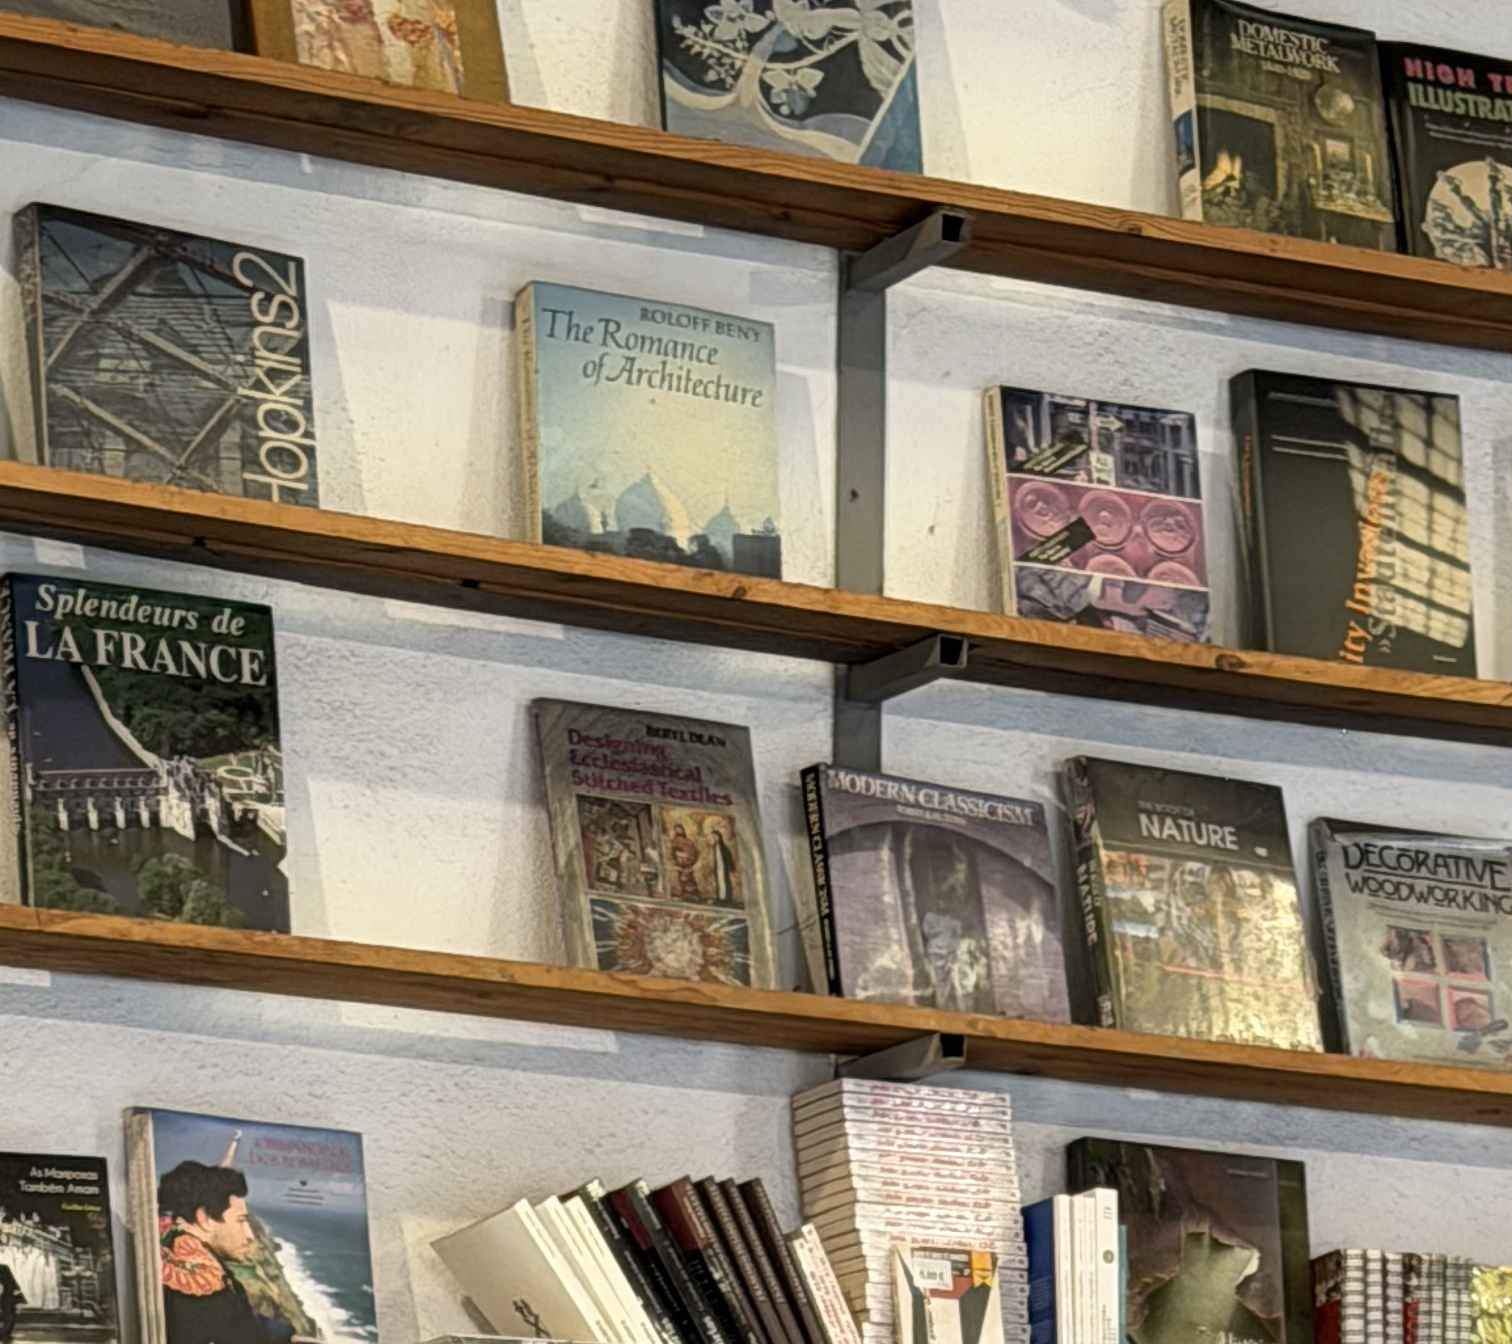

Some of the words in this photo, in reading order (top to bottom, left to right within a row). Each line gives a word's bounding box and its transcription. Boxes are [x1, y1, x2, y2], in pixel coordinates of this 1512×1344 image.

[1230, 33, 1342, 74] METALWORK
[1238, 20, 1329, 55] DOMESTIC
[1404, 56, 1477, 88] HIGH
[541, 307, 594, 346] The
[598, 316, 719, 367] Romance
[640, 307, 710, 332] ROLOFF
[582, 352, 612, 388] of
[606, 355, 764, 409] Architecture
[35, 584, 199, 631] Splendeurs
[211, 608, 246, 638] de
[24, 621, 83, 664] LA
[94, 629, 268, 686] FRANCE
[568, 728, 666, 761] Designing
[657, 780, 733, 805] Textiles
[828, 770, 917, 804] MODERN
[919, 784, 1037, 827] CLASSICISM
[1138, 813, 1239, 850] NATURE
[1342, 843, 1511, 892] DECORATIVE
